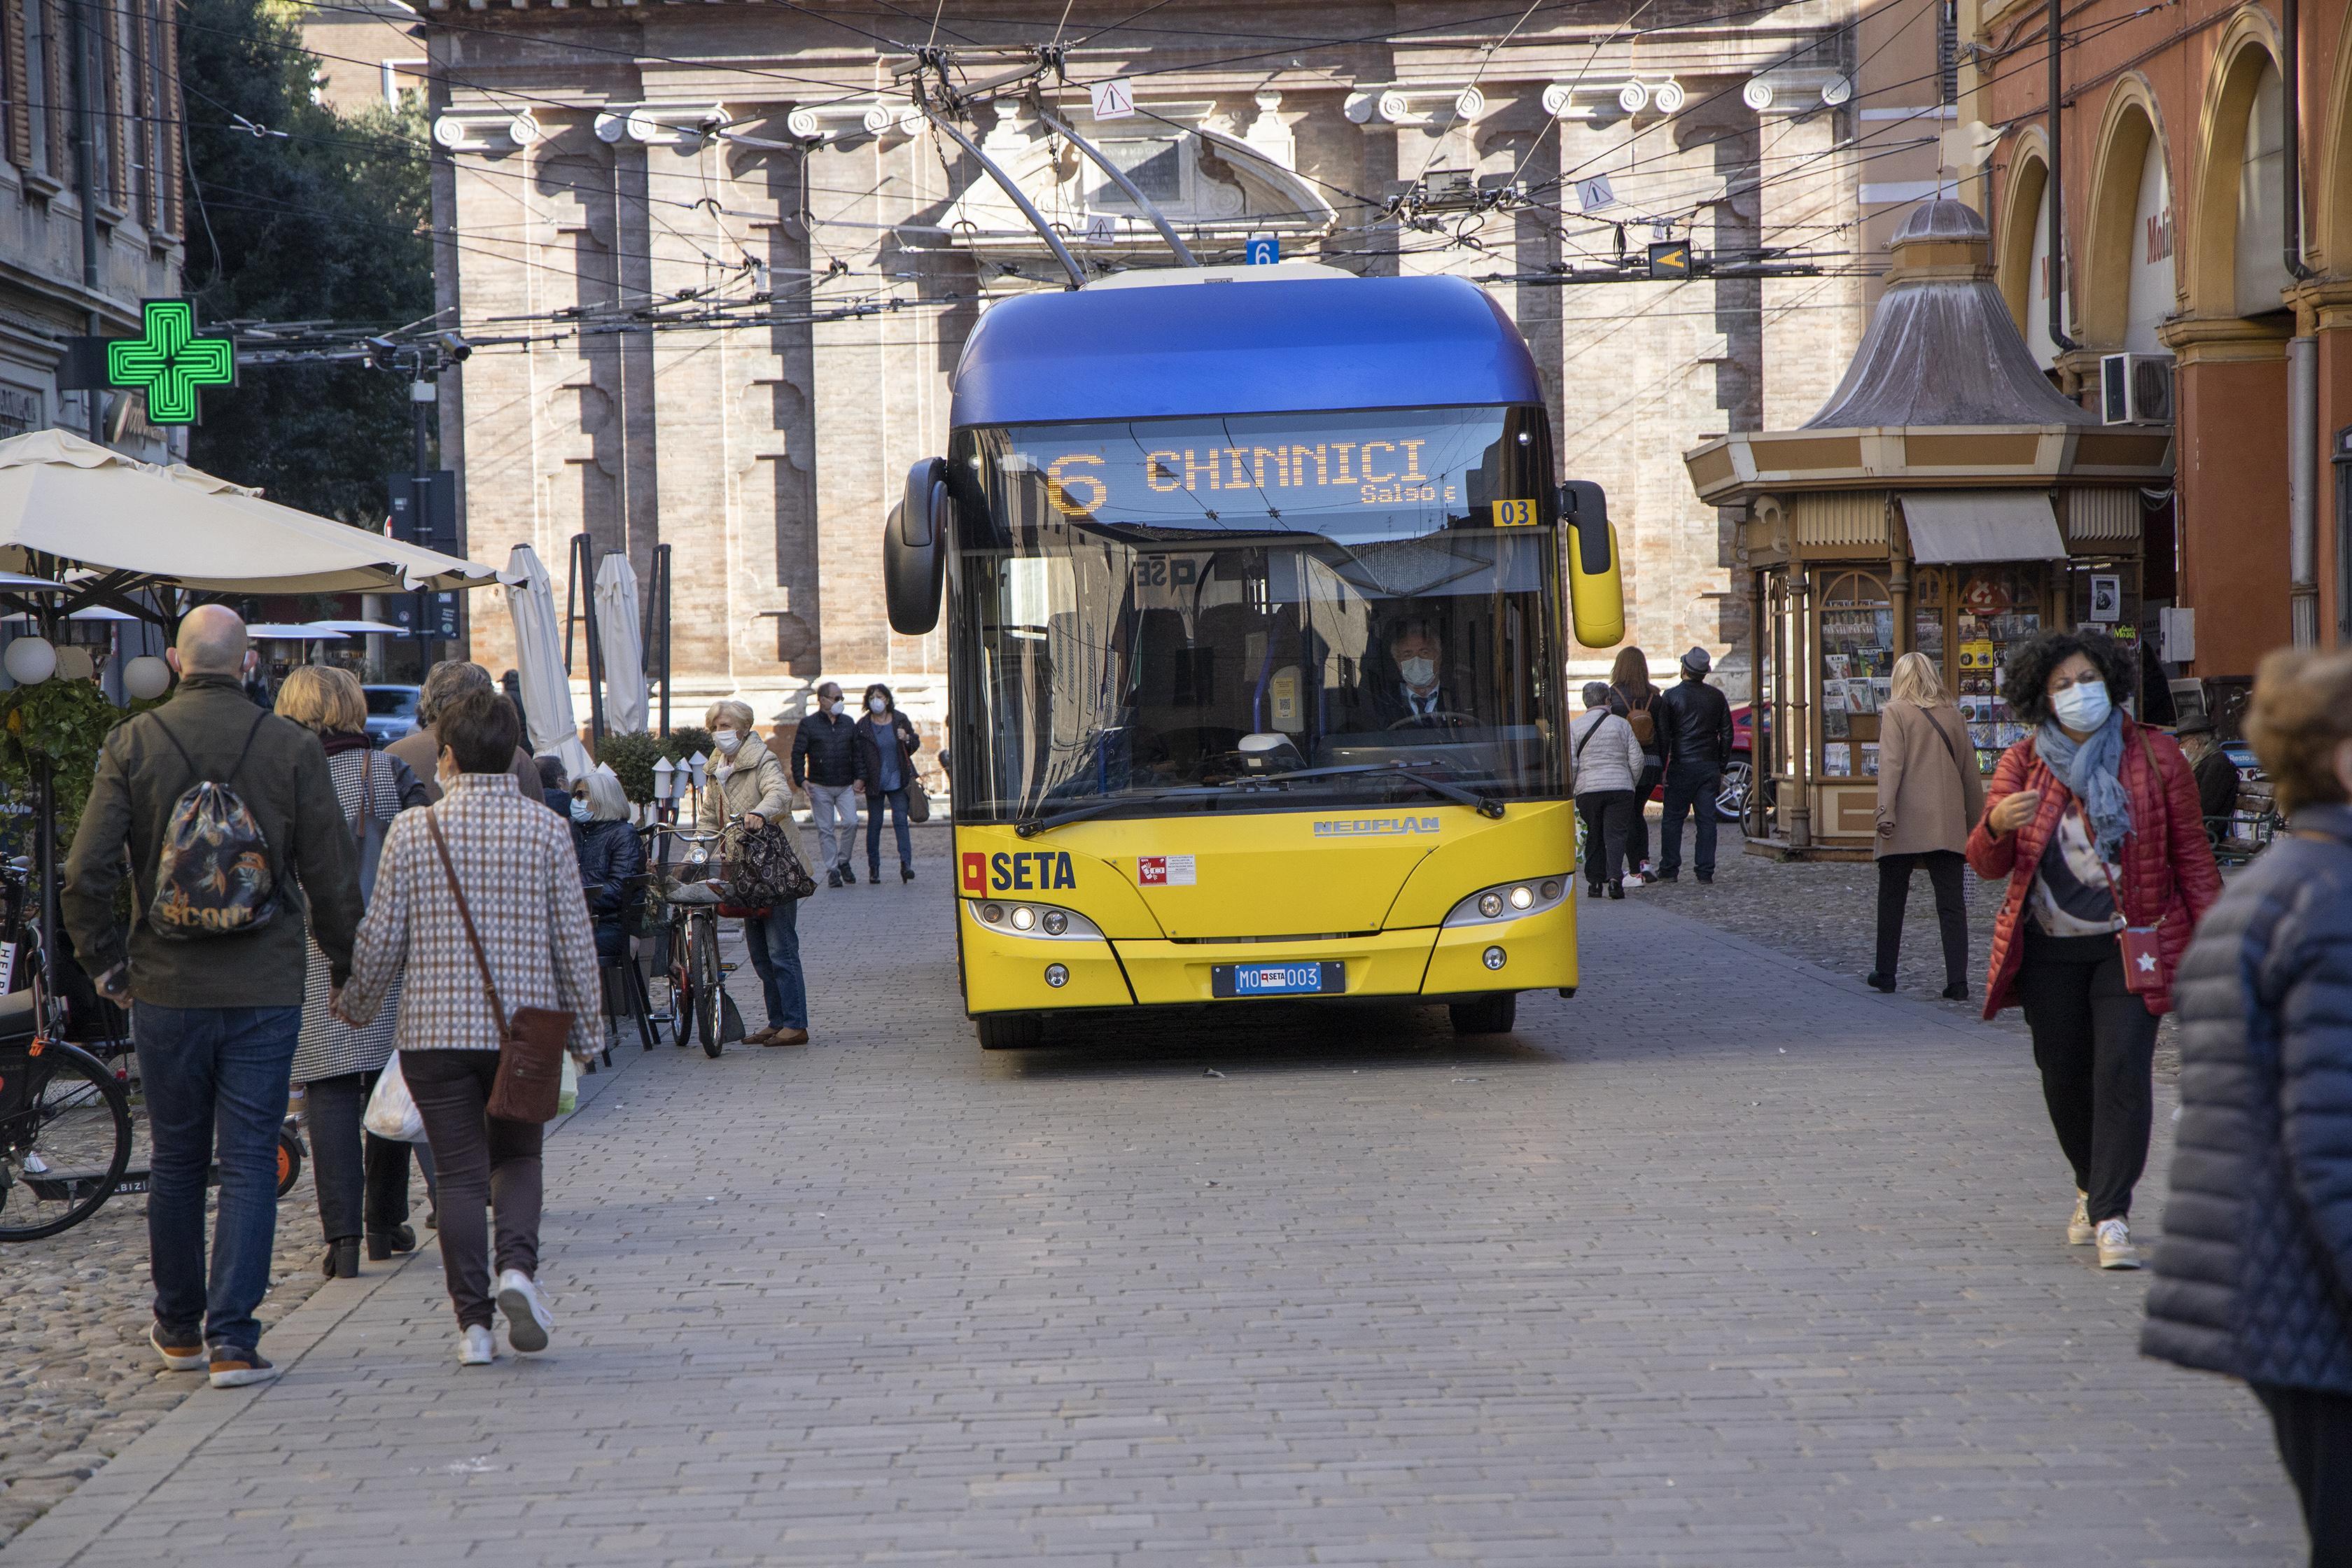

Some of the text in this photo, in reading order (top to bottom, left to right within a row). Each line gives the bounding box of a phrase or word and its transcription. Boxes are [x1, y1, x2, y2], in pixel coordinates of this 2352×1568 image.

[1255, 242, 1271, 265] 6
[1047, 439, 1427, 515] 6 CHINNICI
[1361, 484, 1436, 504] Salso
[1500, 501, 1530, 526] 03
[1314, 817, 1440, 834] NEOPLAN
[991, 851, 1077, 891] SETA
[1239, 968, 1317, 988] MO SETA 003
